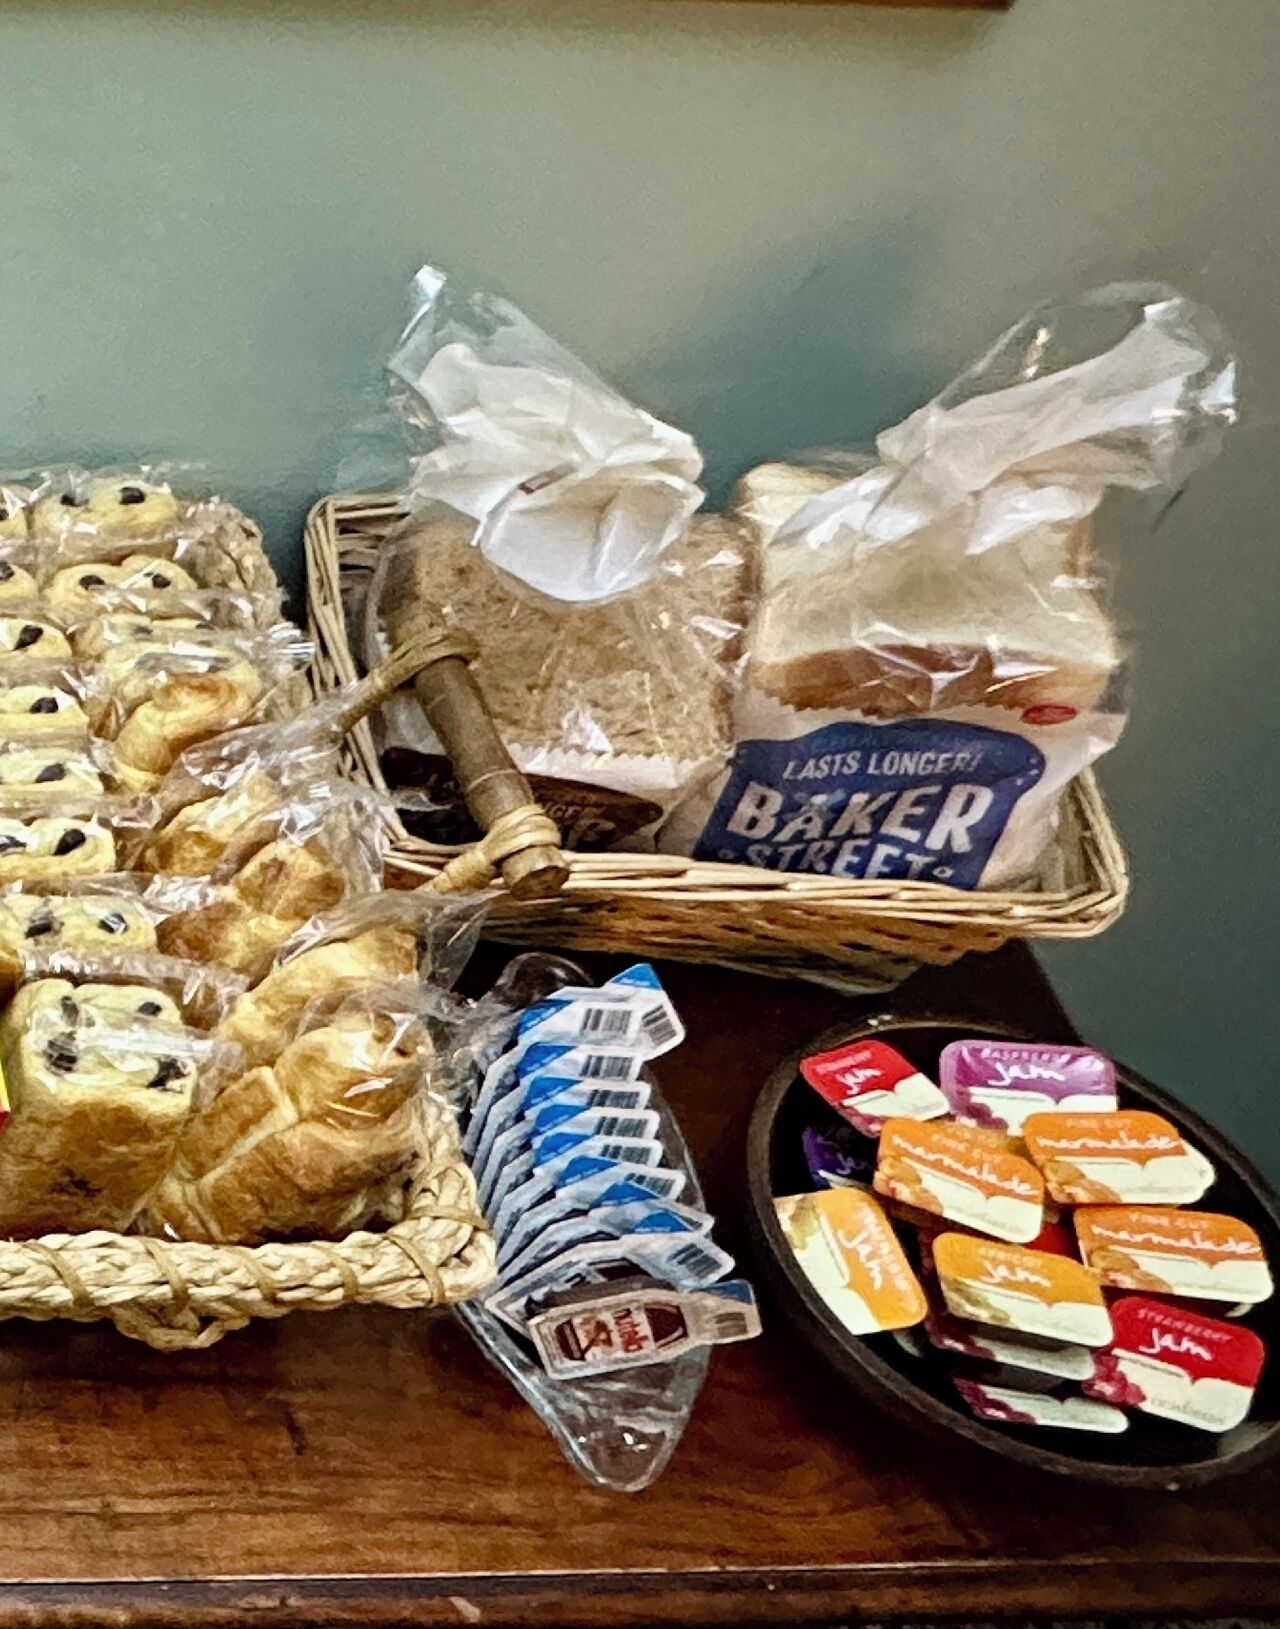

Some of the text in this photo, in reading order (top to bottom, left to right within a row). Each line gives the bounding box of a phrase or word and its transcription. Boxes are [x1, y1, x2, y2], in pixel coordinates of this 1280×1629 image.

[783, 750, 860, 780] LASTS
[726, 781, 995, 854] BAKER
[745, 838, 940, 880] STREET
[1036, 1126, 1182, 1150] marmalade
[1090, 1223, 1262, 1255] marmalade
